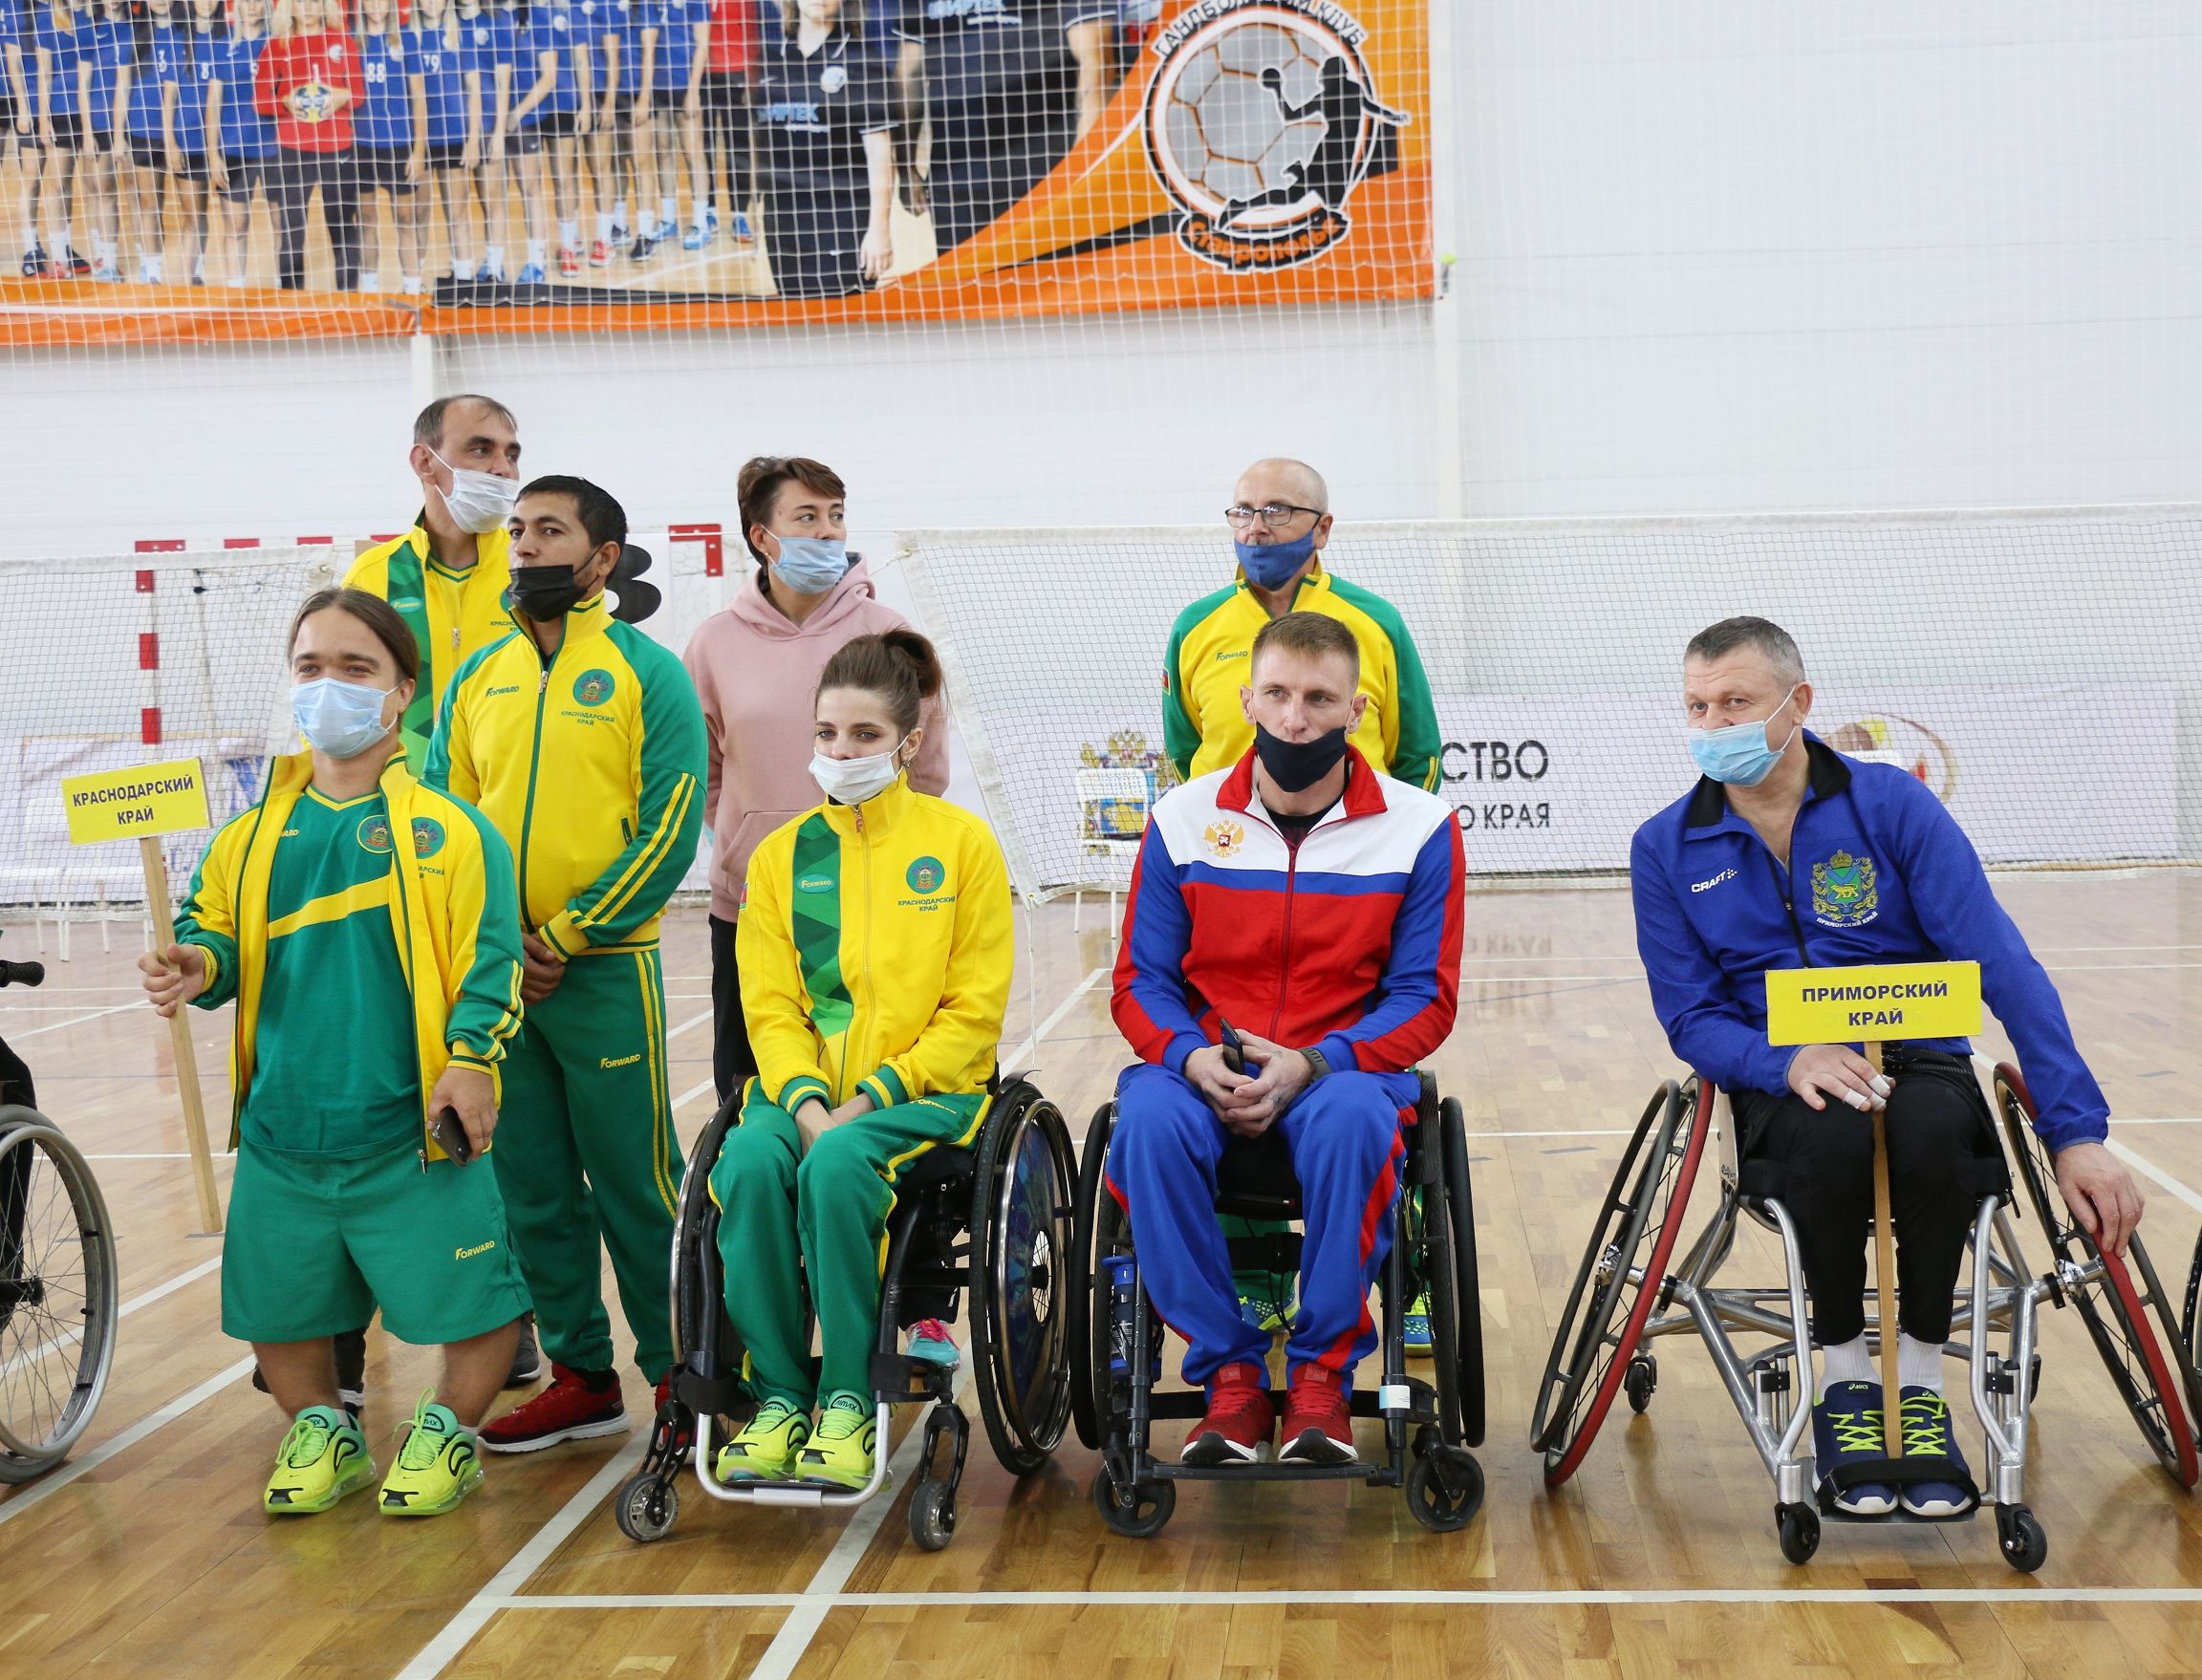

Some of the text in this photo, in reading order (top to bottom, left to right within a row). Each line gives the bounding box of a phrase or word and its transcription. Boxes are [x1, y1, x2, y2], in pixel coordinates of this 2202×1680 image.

[366, 62, 384, 83] 88
[486, 686, 520, 698] FORWARD
[560, 711, 615, 722] КРАСНОДАРСКИЙ
[1441, 740, 1548, 781] СТВО
[73, 774, 194, 807] КРАСНОДАРСКИЙ
[117, 805, 154, 825] КРАЙ
[1483, 804, 1549, 829] КРАЯ
[1691, 871, 1726, 893] CRAFT
[1816, 911, 1879, 928] ПРИМОРСКИЙ КРАЙ
[1802, 980, 1948, 1002] ПРИМОРСКИЙ
[1848, 1008, 1903, 1026] КРАЙ
[600, 1054, 641, 1069] FORWARD
[455, 1240, 495, 1261] FORWARD
